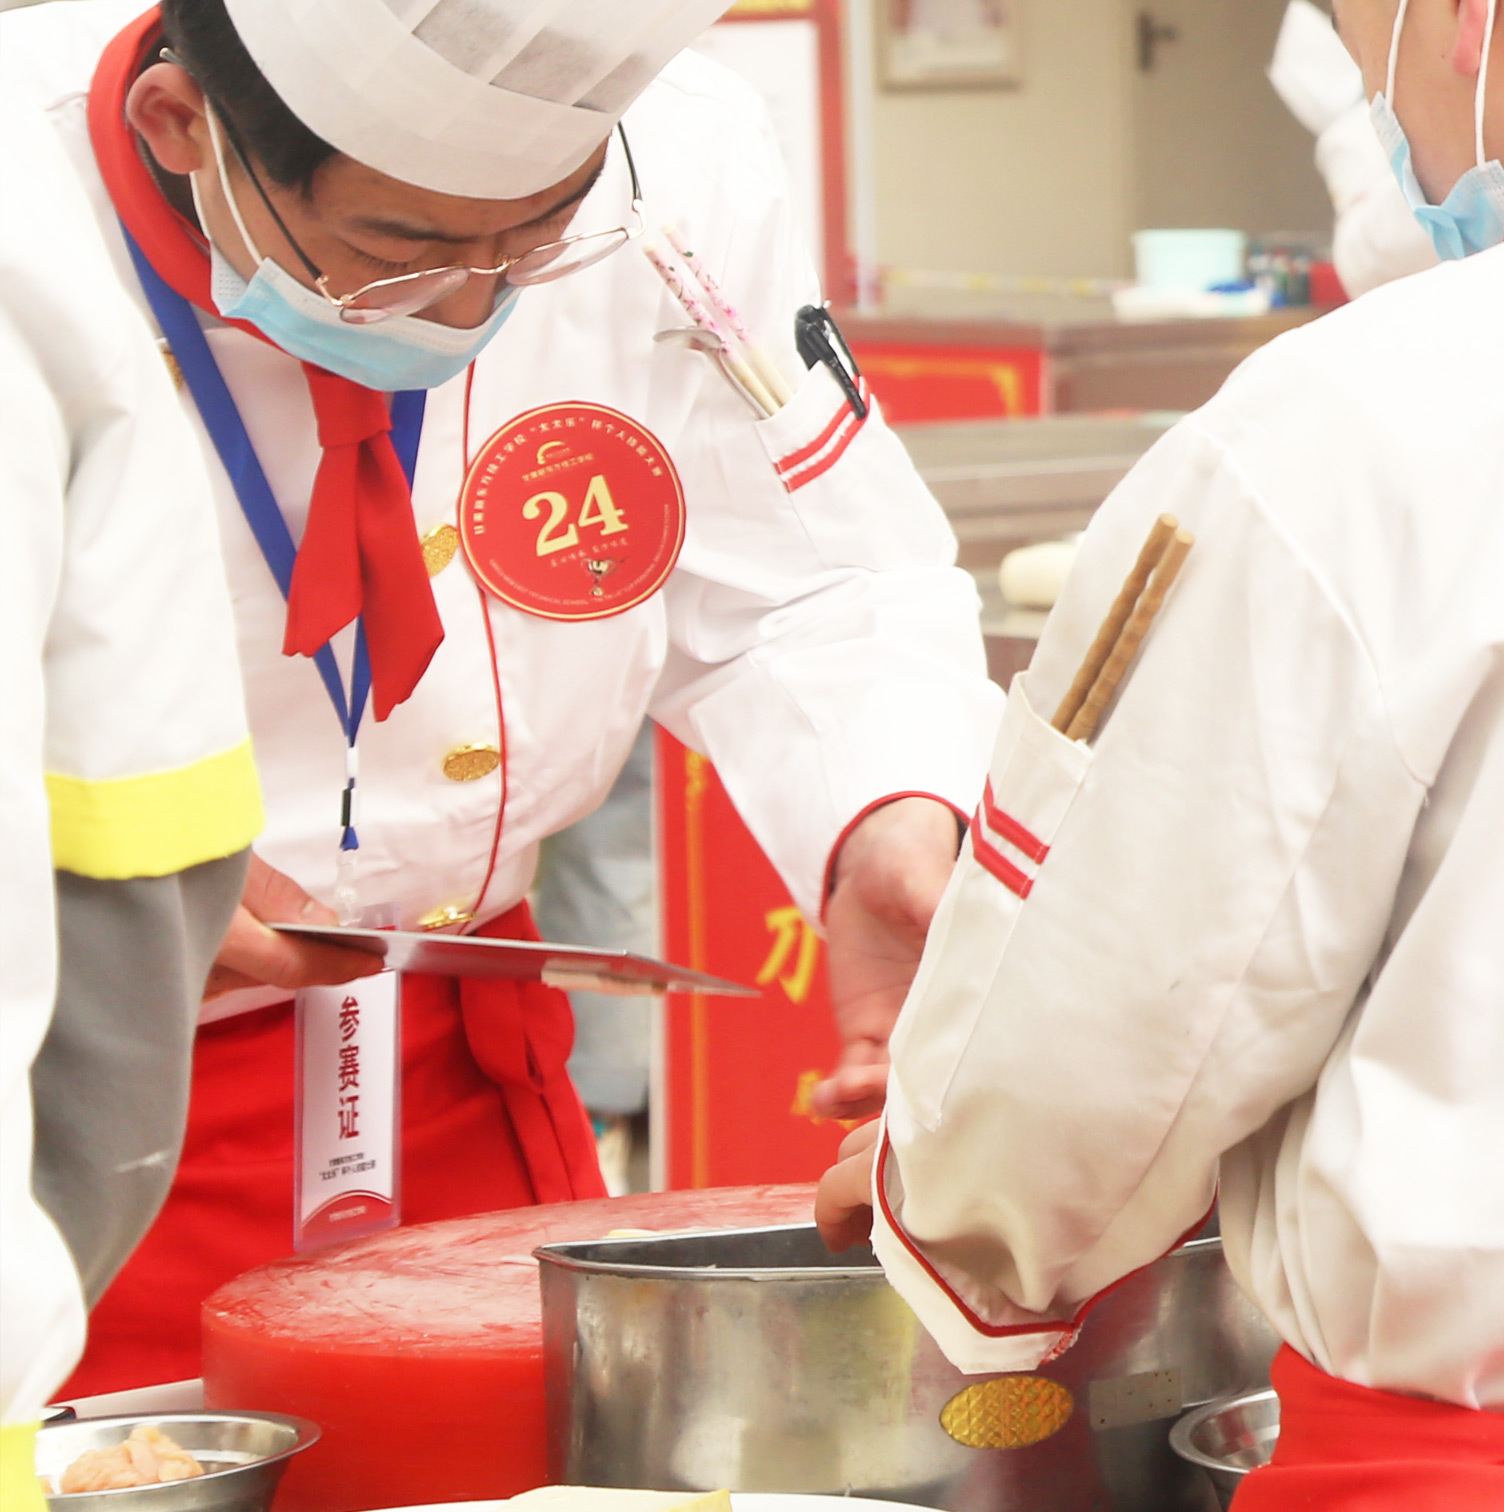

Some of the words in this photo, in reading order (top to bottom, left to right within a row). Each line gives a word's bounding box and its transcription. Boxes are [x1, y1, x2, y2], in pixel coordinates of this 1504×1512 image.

[522, 474, 629, 557] 24
[337, 995, 360, 1140] 参赛证
